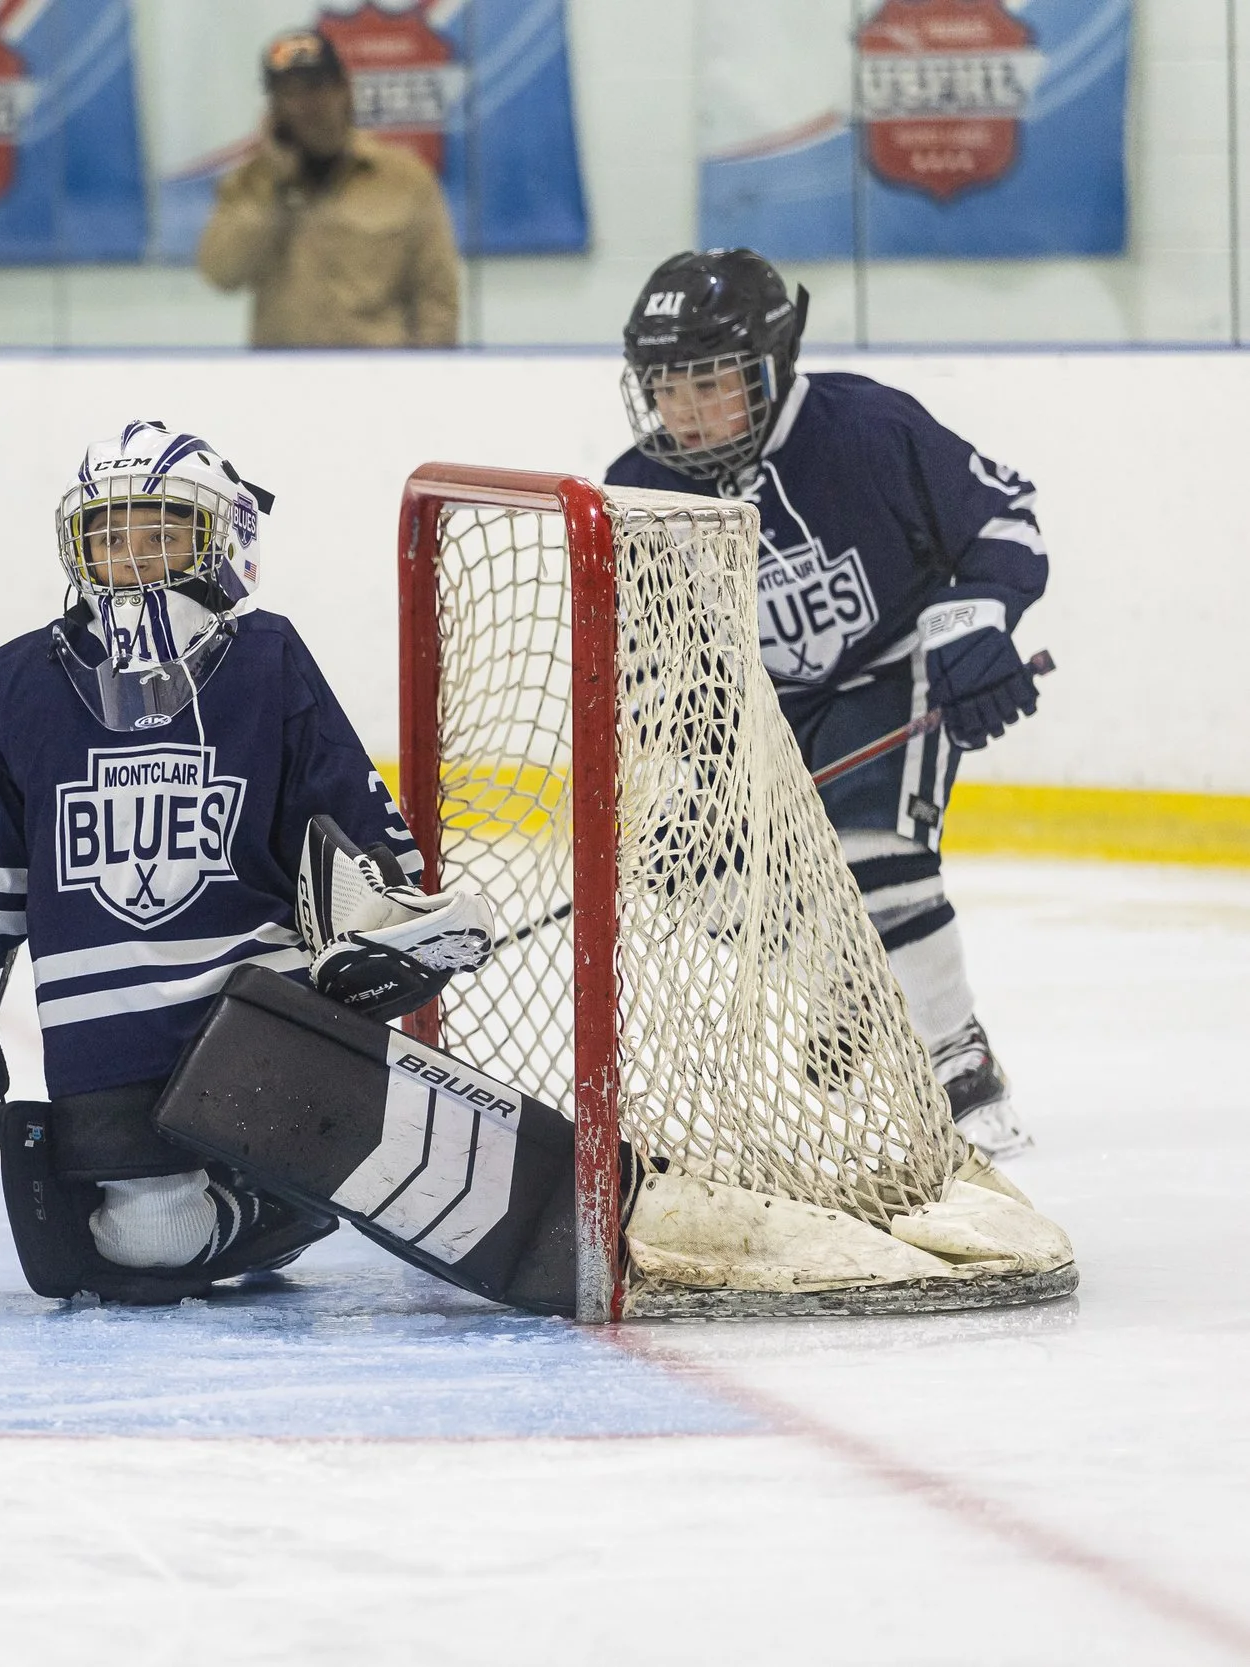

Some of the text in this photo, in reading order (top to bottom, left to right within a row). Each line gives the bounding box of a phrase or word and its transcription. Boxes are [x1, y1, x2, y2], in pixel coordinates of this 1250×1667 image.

[94, 457, 153, 471] CCM
[233, 505, 256, 534] BLUES
[104, 761, 198, 788] MONTCLAIR
[68, 791, 225, 868] BLUES
